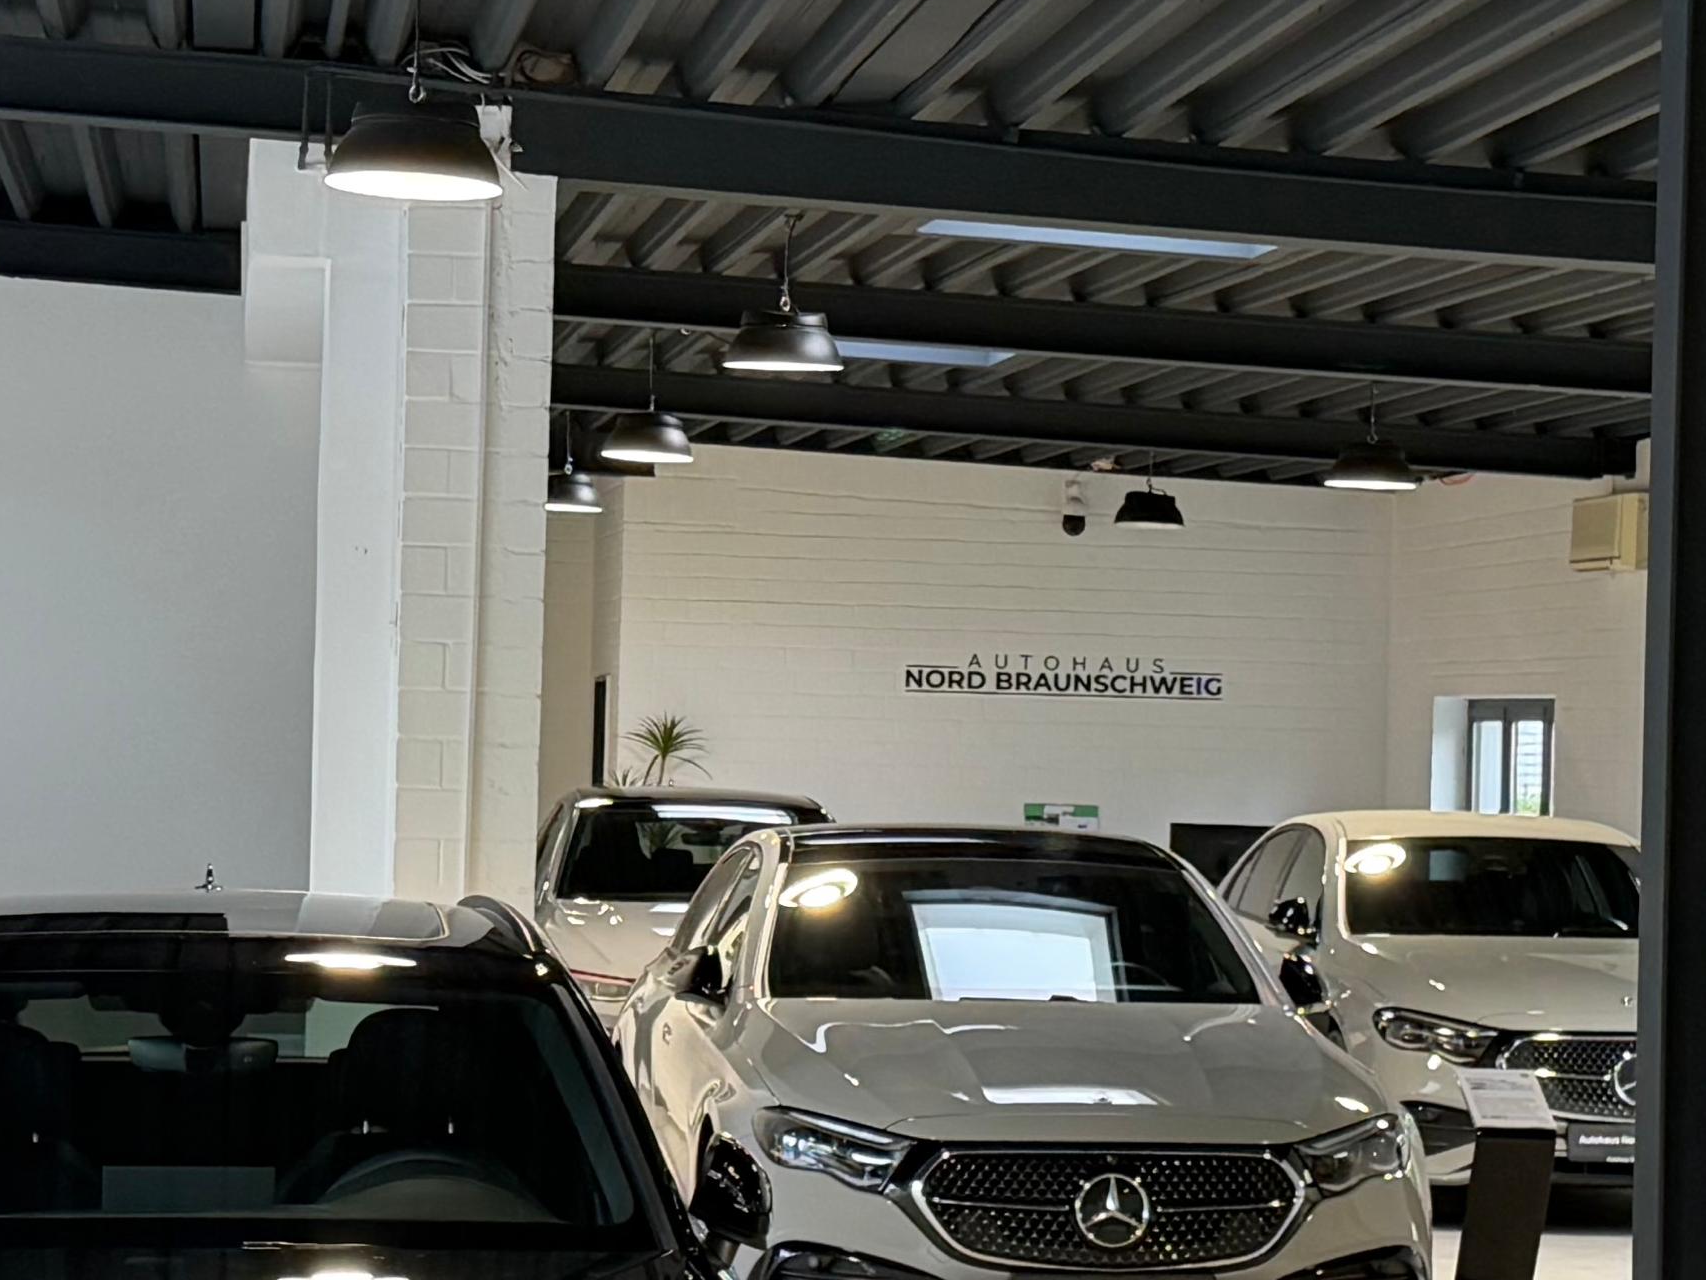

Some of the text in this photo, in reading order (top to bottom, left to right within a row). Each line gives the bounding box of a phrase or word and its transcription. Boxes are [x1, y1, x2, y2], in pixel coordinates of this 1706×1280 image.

[967, 653, 1165, 674] AUTOHAUS
[904, 668, 1223, 697] NORD BRAUNSCHWEIG
